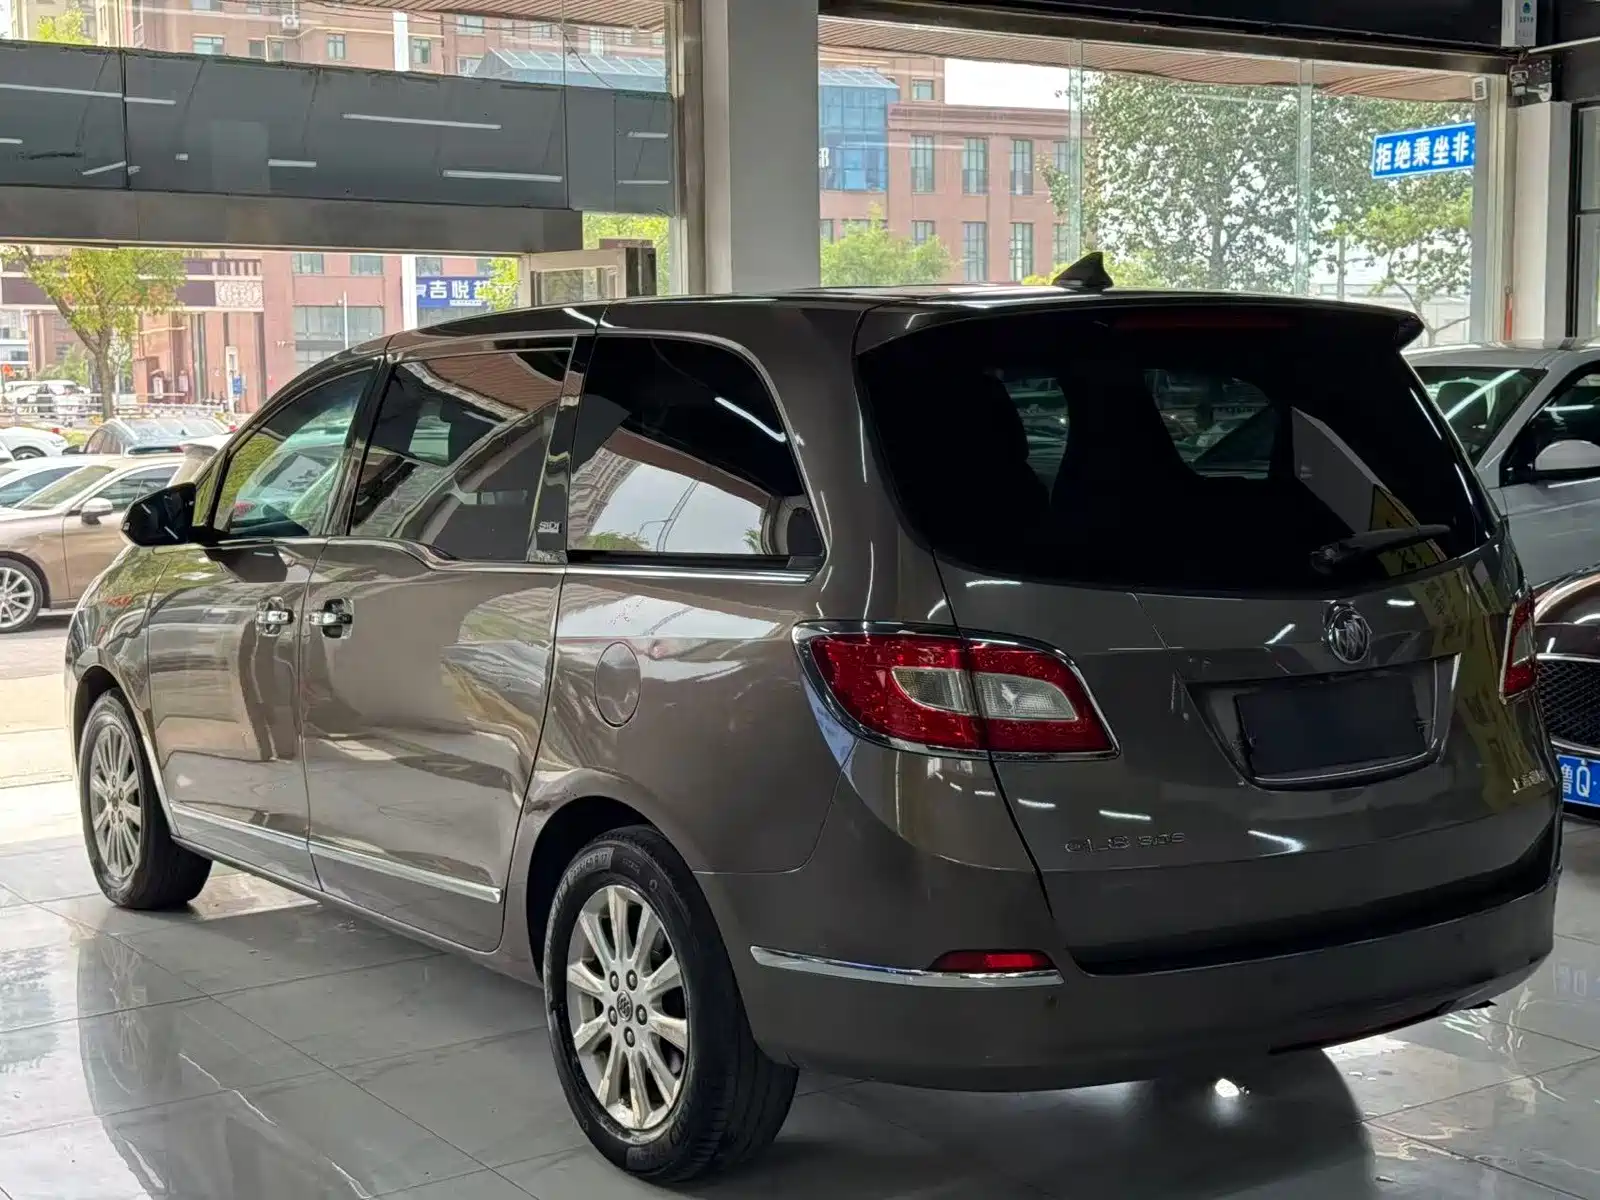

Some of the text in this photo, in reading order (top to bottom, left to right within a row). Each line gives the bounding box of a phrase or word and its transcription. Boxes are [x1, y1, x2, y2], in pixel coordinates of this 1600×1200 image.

[1375, 131, 1475, 172] 拒绝乘坐非
